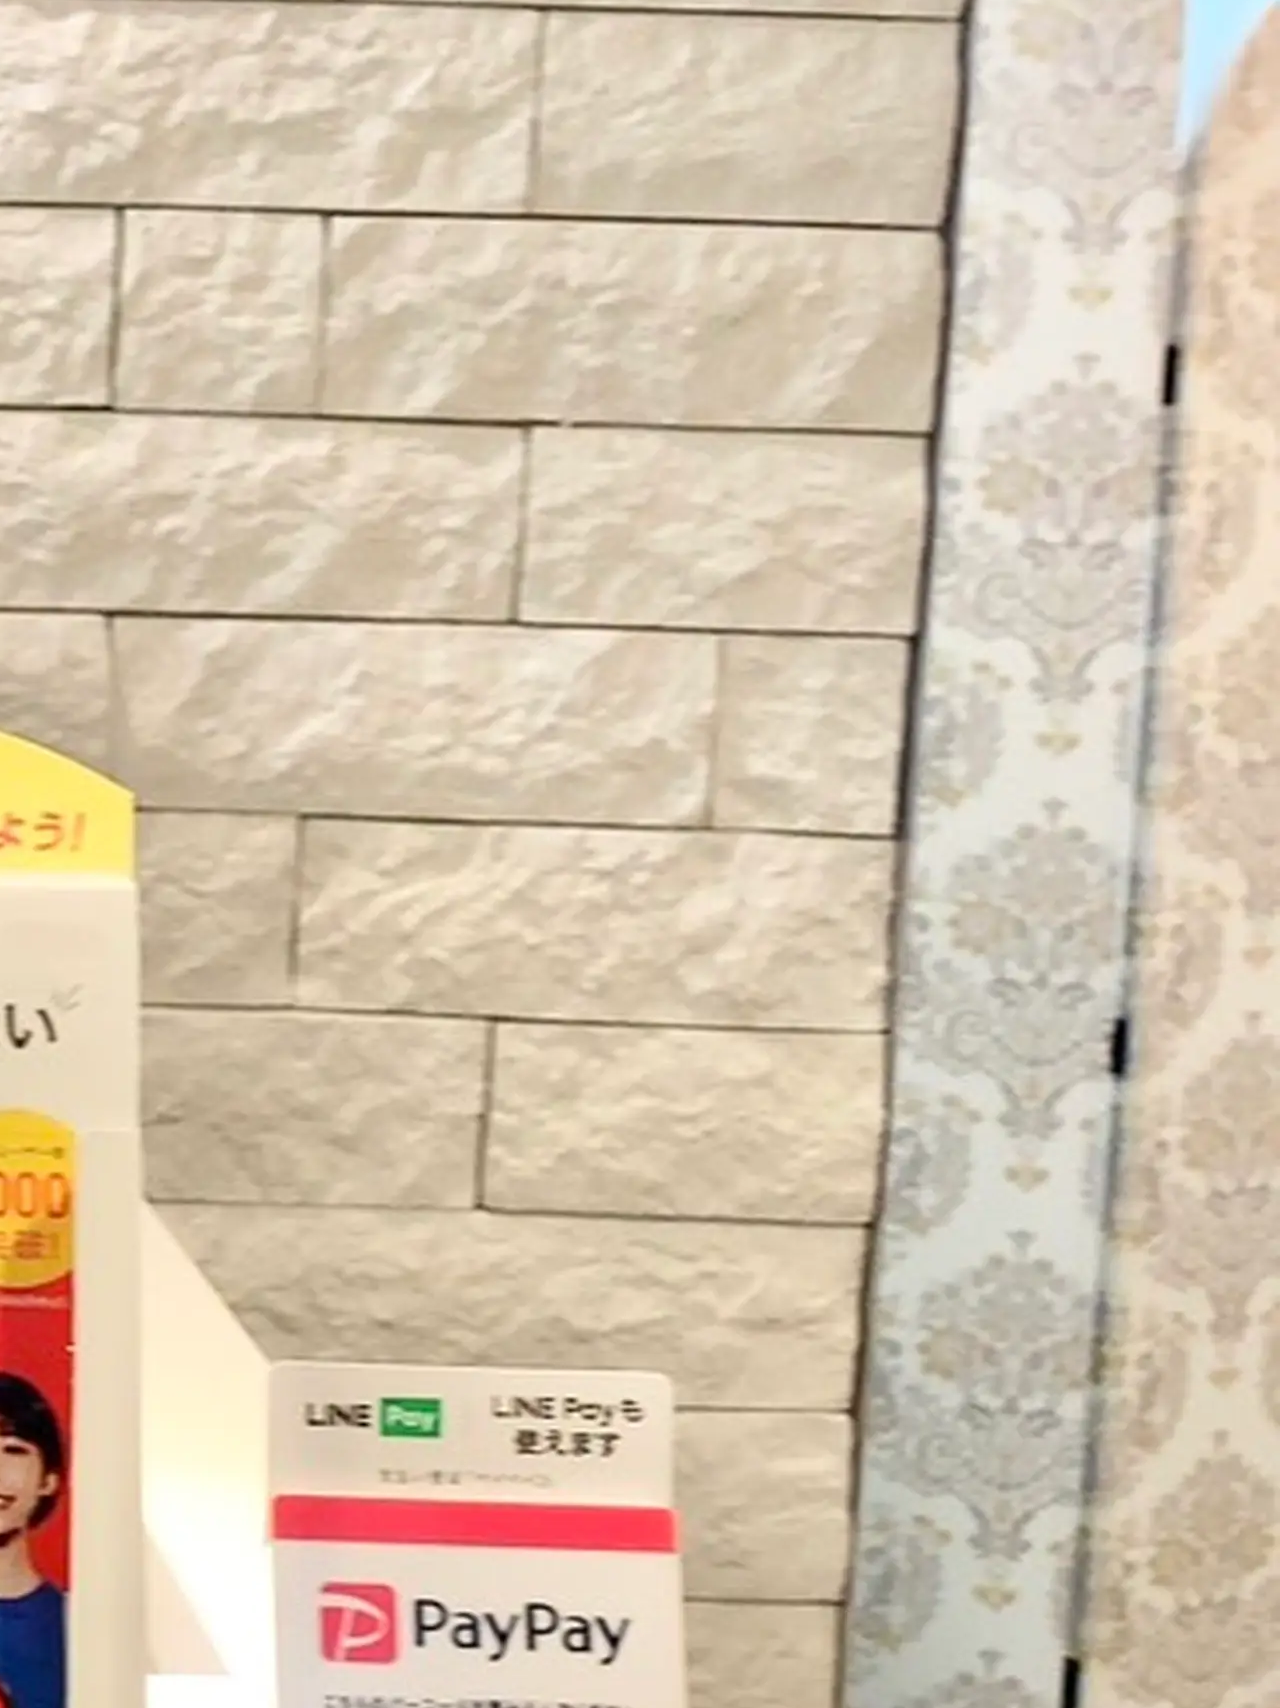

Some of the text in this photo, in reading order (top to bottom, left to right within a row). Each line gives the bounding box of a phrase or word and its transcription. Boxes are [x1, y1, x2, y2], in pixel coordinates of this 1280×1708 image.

[305, 1403, 439, 1433] LINE Pay
[491, 1395, 558, 1420] LINE
[513, 1429, 622, 1457] 使えます
[413, 1597, 633, 1666] PayPay
